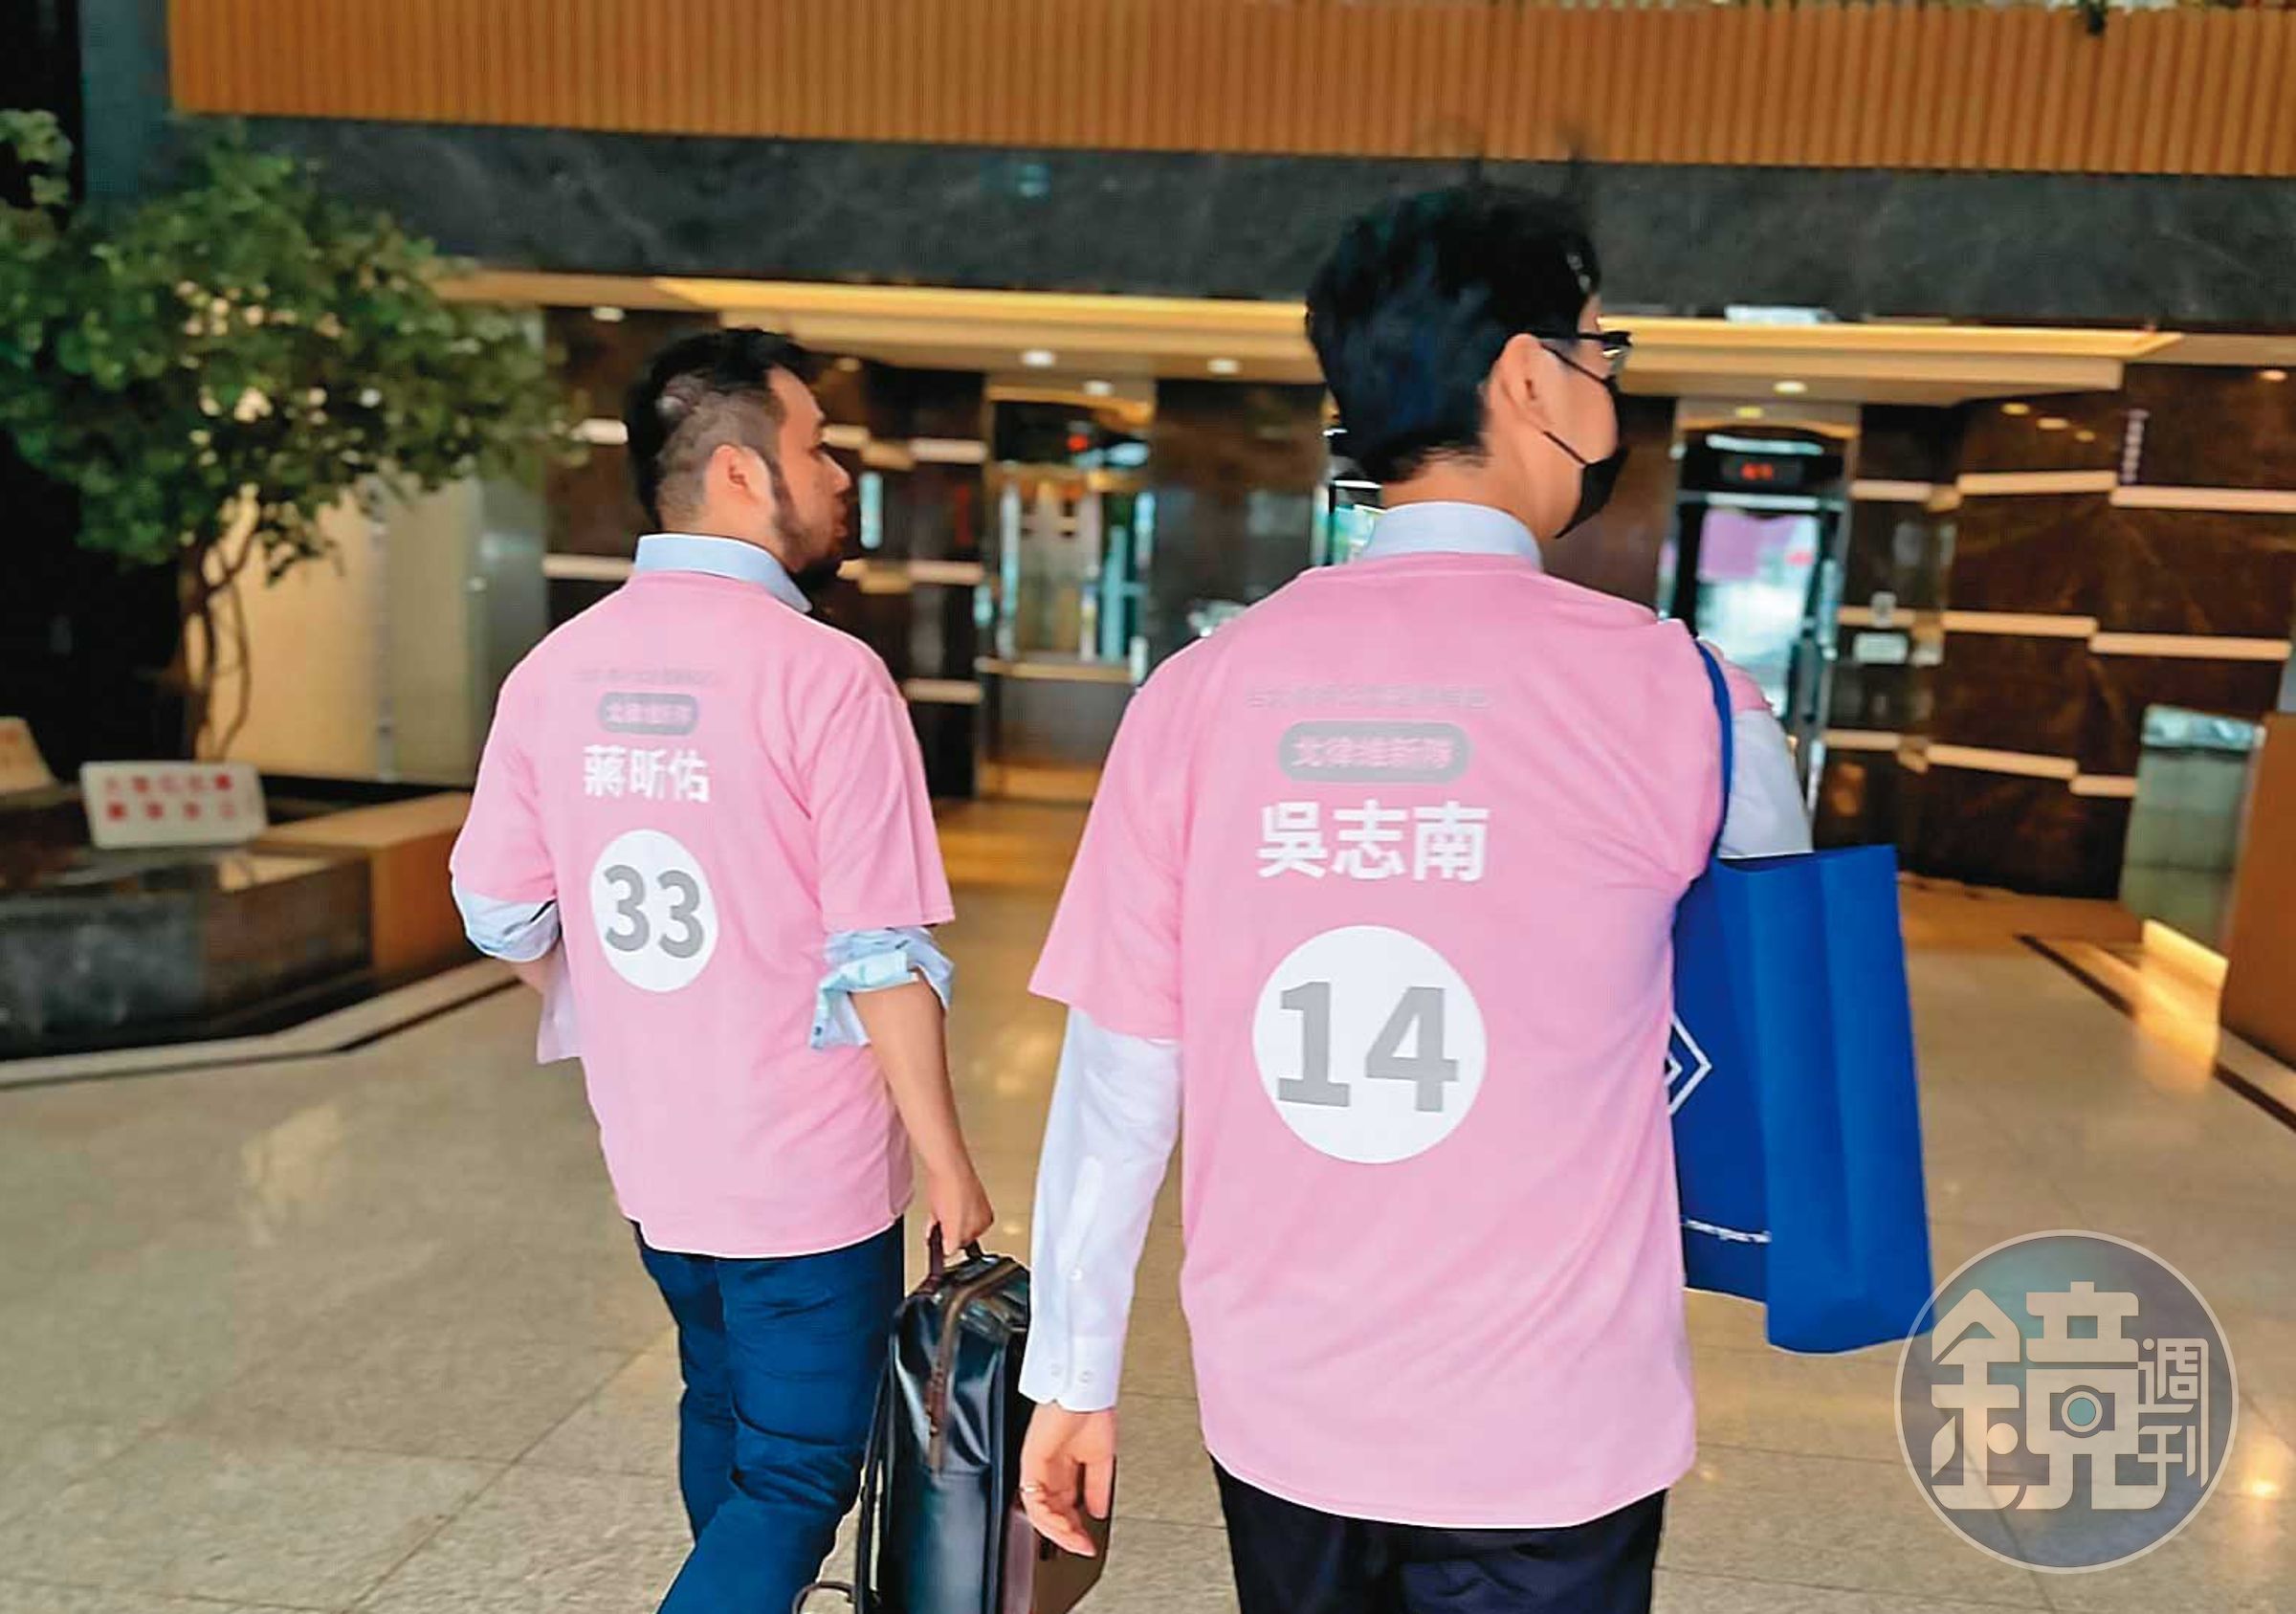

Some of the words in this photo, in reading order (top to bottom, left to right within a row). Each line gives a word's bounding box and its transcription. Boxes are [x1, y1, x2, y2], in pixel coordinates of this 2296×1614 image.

[583, 743, 711, 804] 蔣昕佑
[1256, 798, 1490, 882] 吳志南
[604, 864, 704, 959] 33
[1278, 981, 1459, 1113] 14
